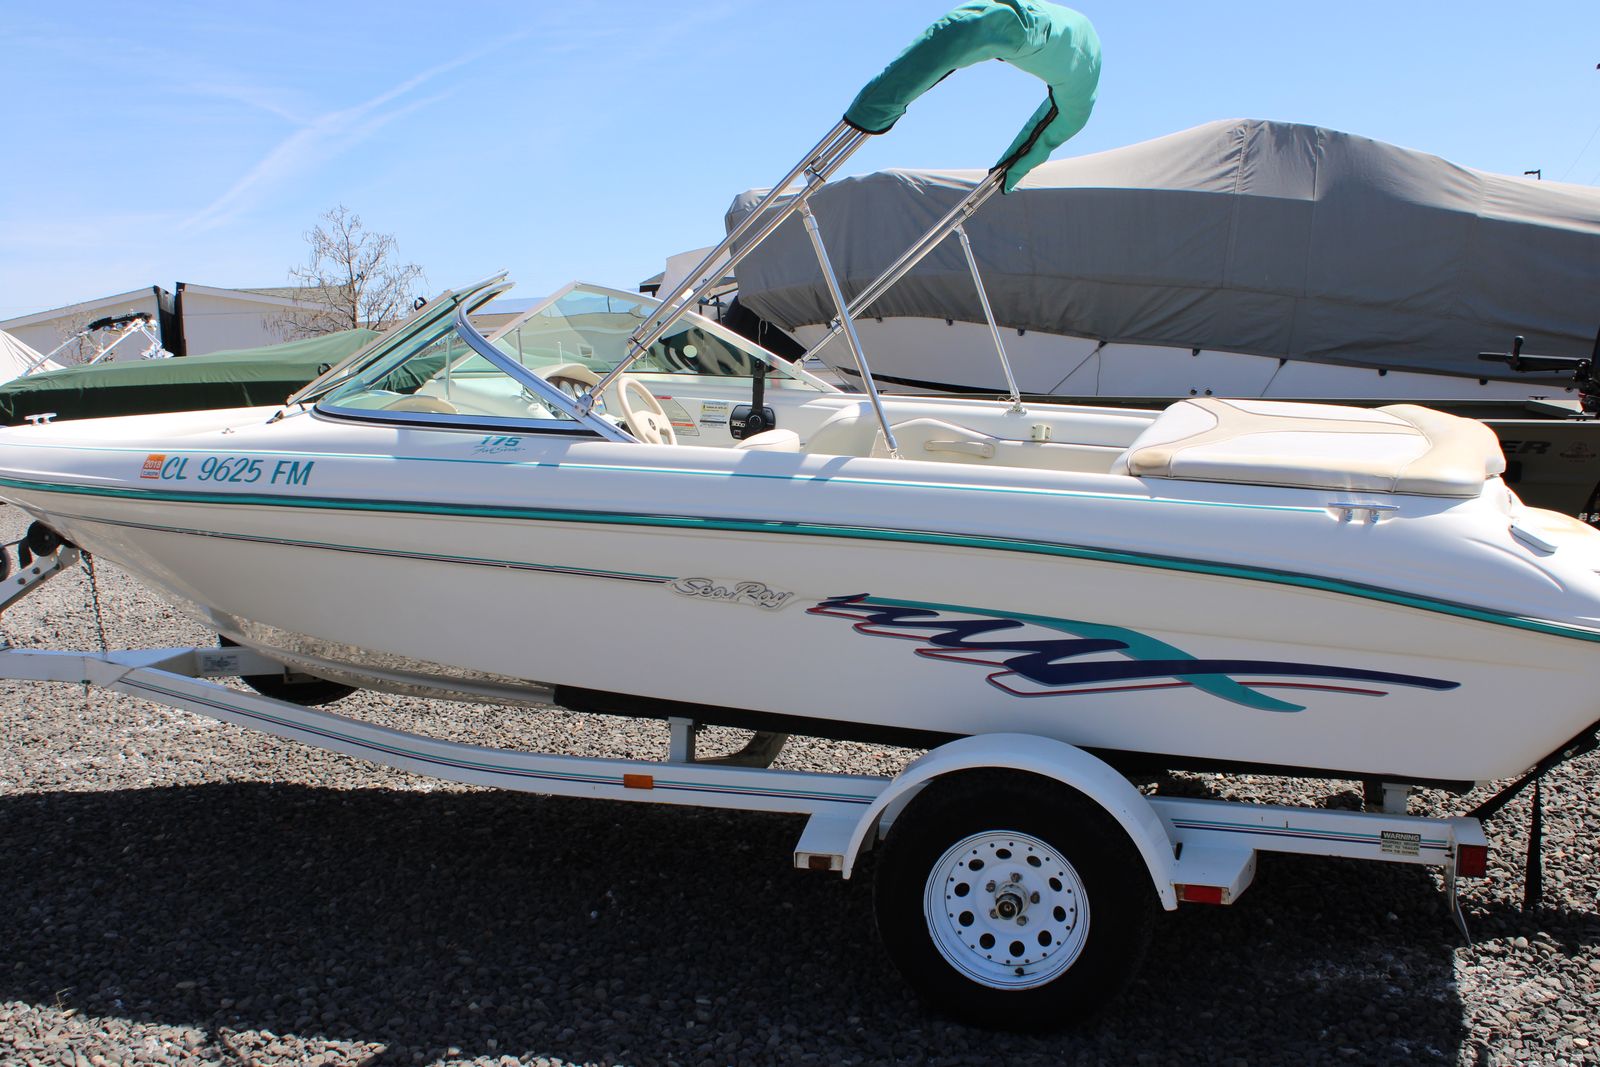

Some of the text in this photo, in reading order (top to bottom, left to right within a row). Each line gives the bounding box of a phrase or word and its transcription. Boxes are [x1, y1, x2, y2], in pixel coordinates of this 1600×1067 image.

[480, 436, 522, 446] 175
[161, 456, 315, 486] CL 9625 FM
[1383, 832, 1420, 841] WARNING
